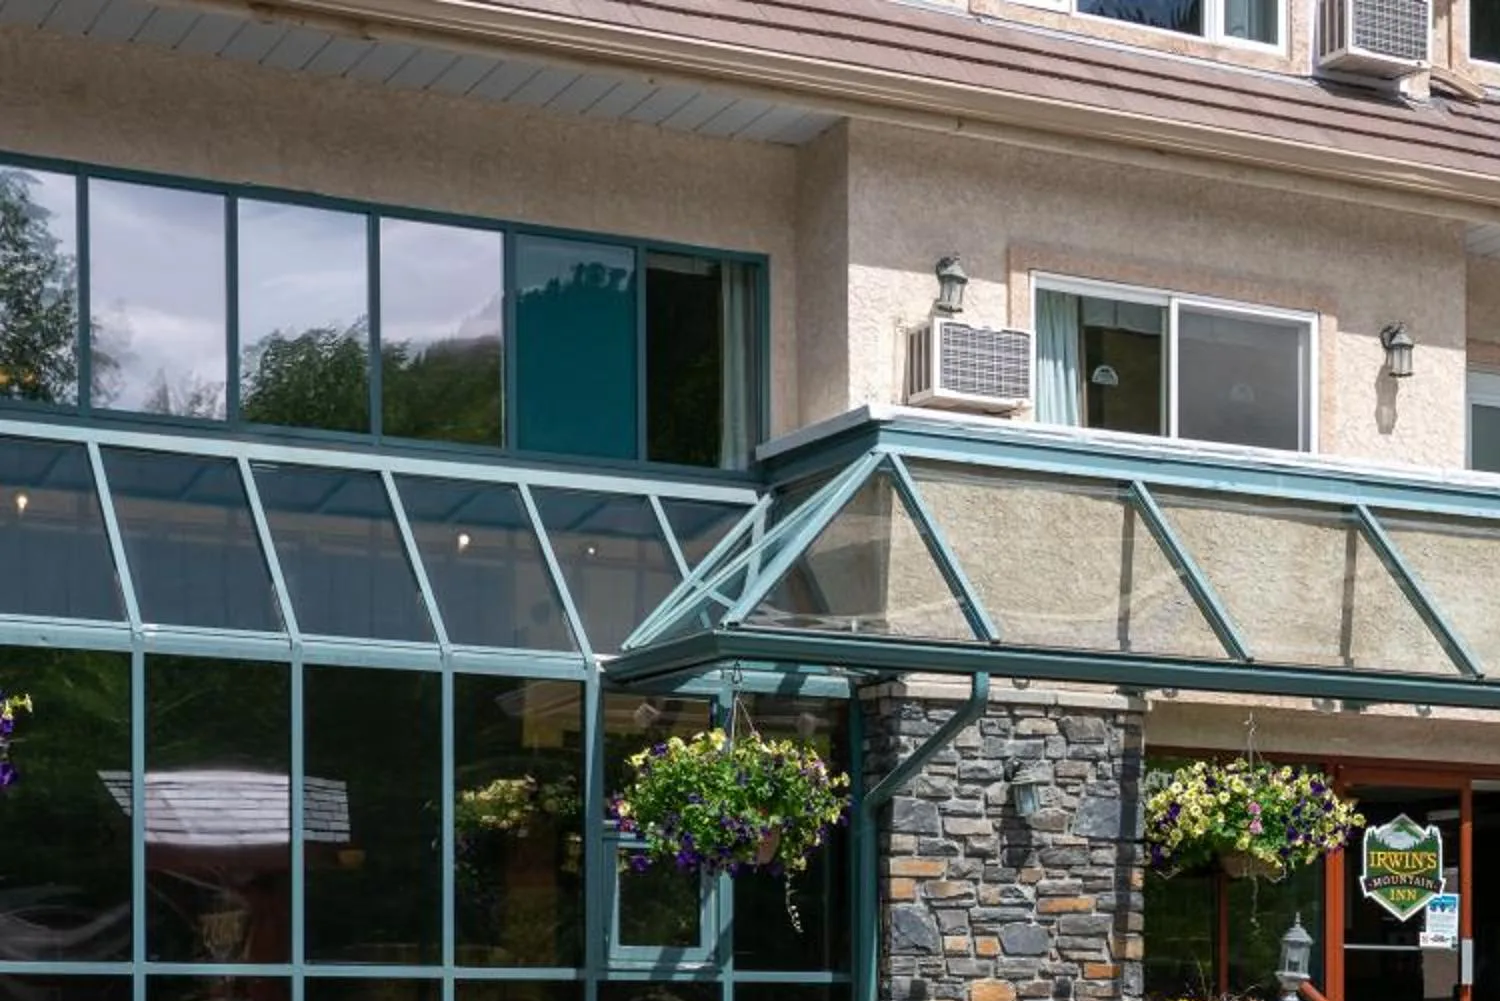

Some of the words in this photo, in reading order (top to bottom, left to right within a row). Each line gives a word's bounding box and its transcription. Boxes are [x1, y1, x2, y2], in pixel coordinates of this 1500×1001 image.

[1369, 851, 1437, 874] IRWIN'S
[1373, 875, 1433, 889] MOUNTAIN
[1391, 889, 1417, 900] INN
